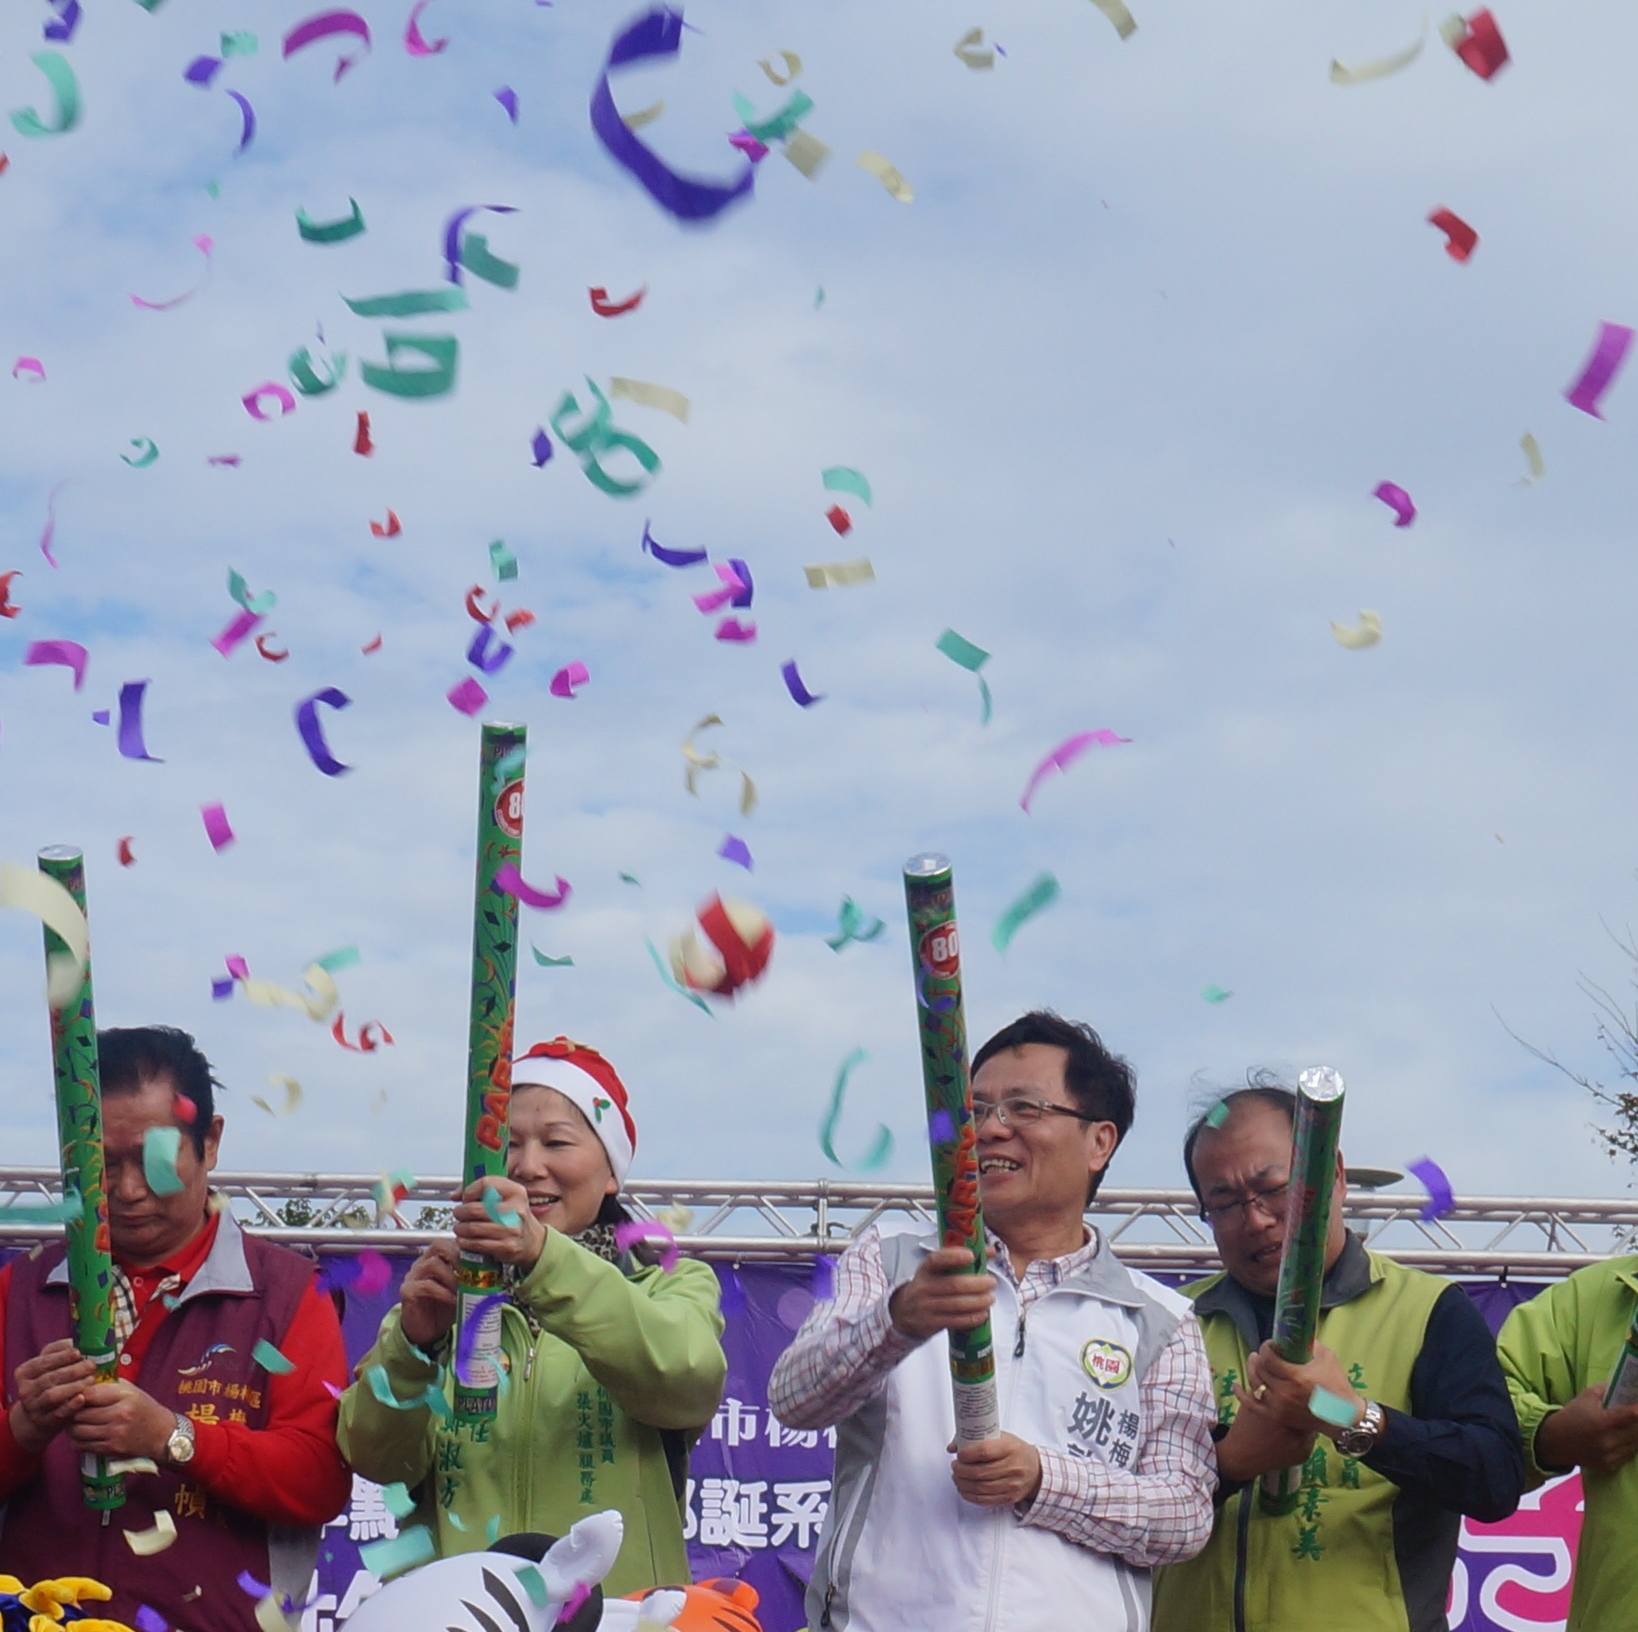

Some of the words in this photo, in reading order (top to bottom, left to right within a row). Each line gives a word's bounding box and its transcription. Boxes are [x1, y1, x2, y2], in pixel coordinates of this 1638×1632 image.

[932, 931, 958, 962] 80
[1092, 1353, 1120, 1375] 桃園
[1108, 1409, 1140, 1468] 楊梅
[683, 1477, 833, 1549] 誕系
